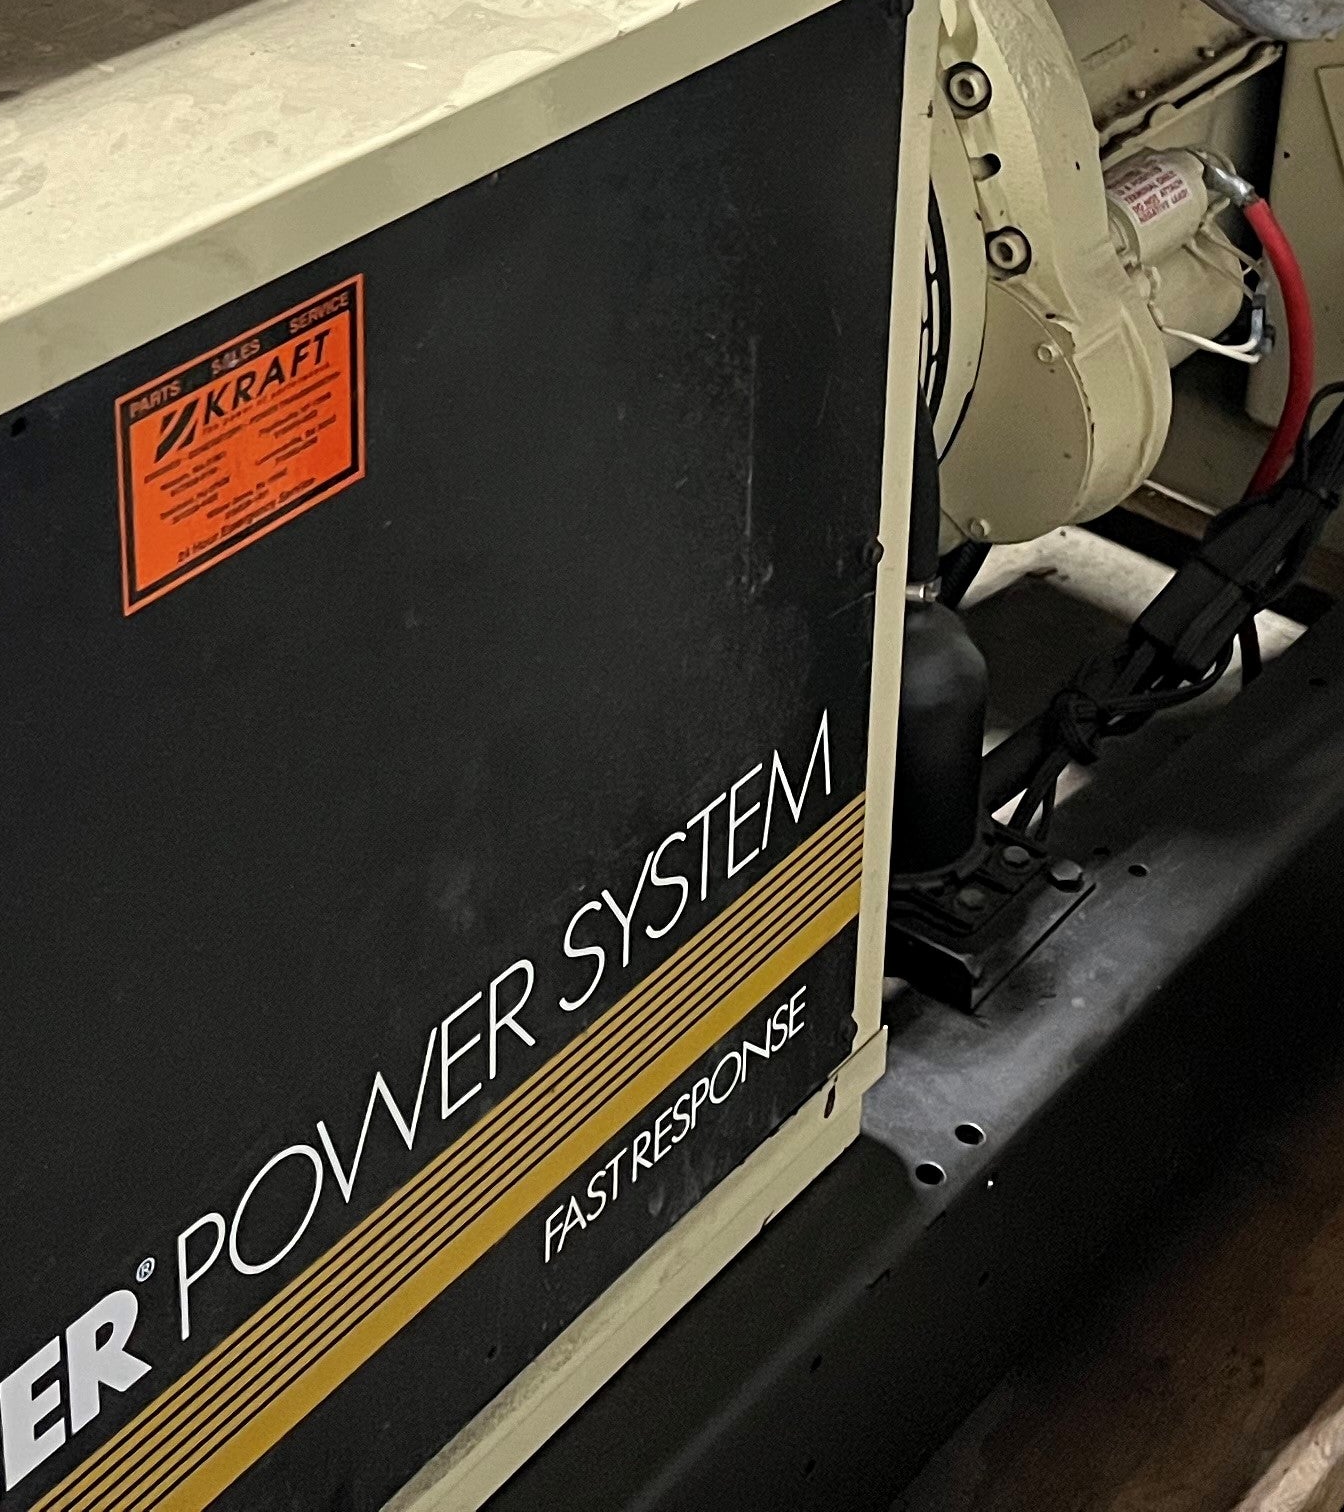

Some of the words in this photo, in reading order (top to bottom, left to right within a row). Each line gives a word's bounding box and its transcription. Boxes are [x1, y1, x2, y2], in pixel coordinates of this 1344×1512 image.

[130, 379, 182, 419] PARTS
[210, 338, 261, 375] SALES
[288, 290, 350, 334] SERVICE
[204, 328, 332, 425] KRAFT
[177, 958, 535, 1341] POWER
[559, 708, 831, 1012] SYSTEM
[544, 1146, 628, 1264] FAST
[631, 985, 807, 1183] RESPONSE
